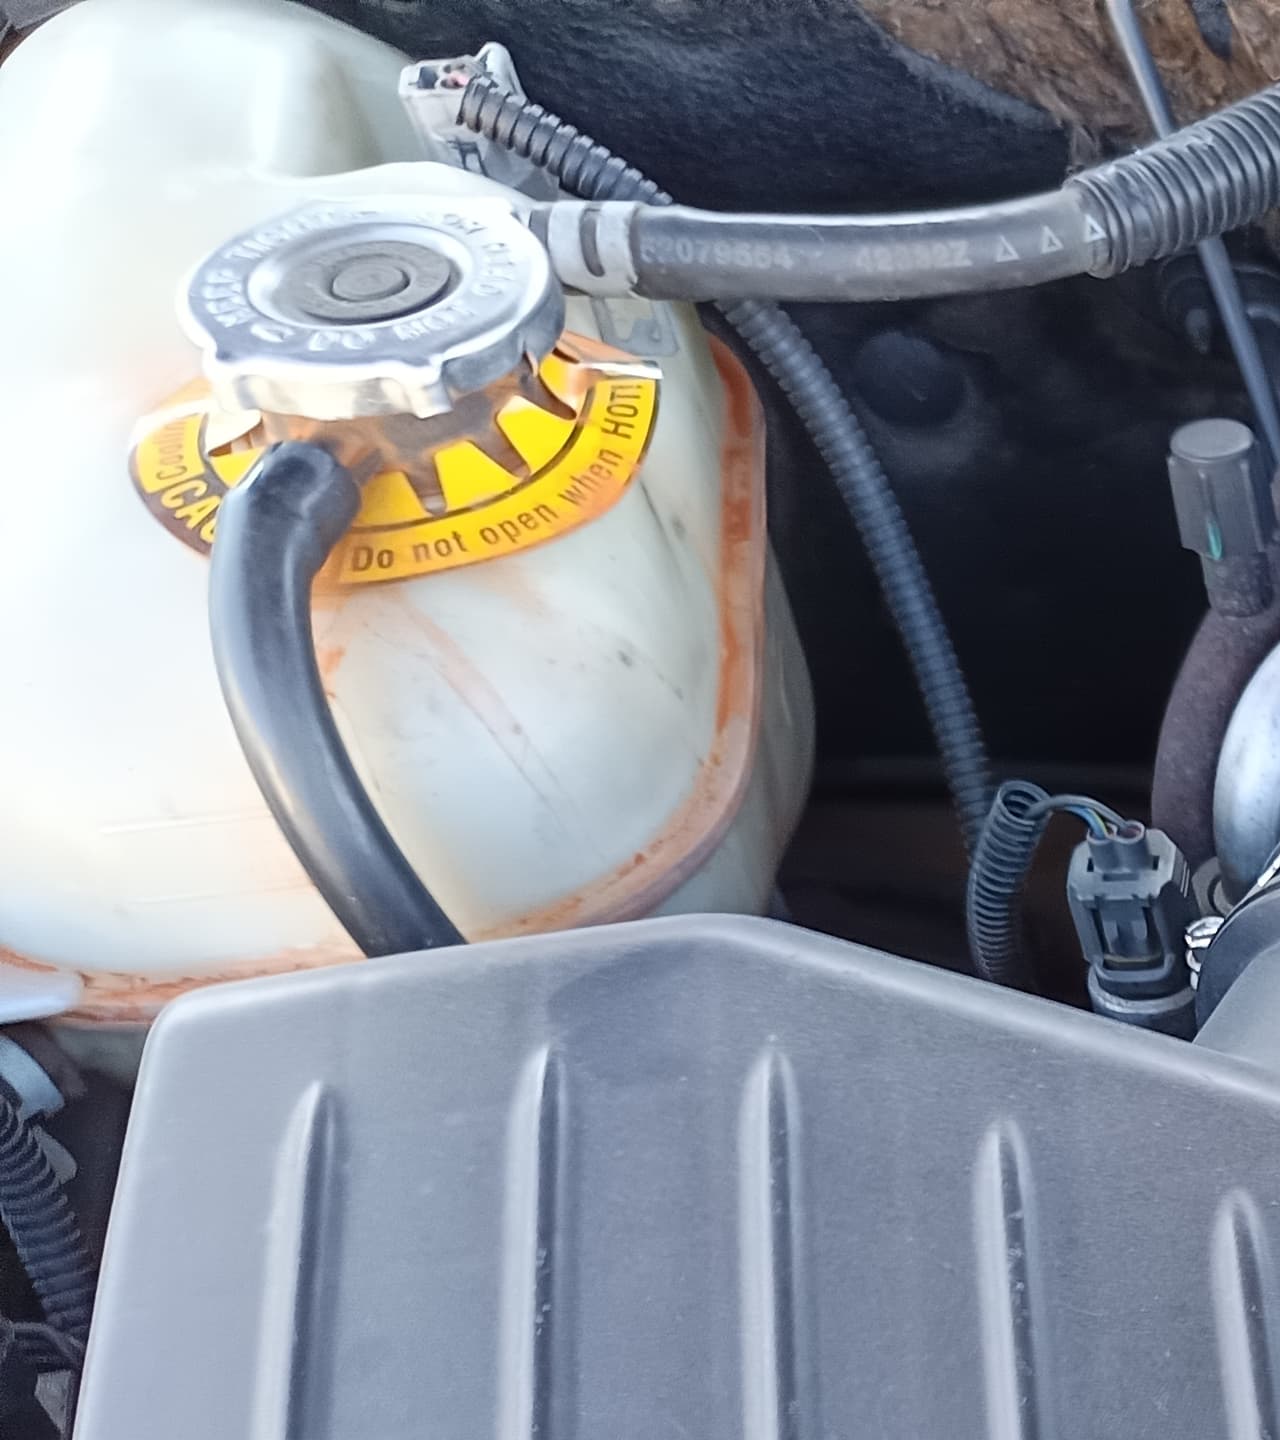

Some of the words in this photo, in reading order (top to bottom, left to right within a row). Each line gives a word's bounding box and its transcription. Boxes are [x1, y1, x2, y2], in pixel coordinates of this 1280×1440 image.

[351, 546, 395, 572] Do
[411, 531, 469, 563] not
[479, 502, 560, 544] open
[557, 449, 624, 507] when
[600, 384, 643, 440] HOT!
